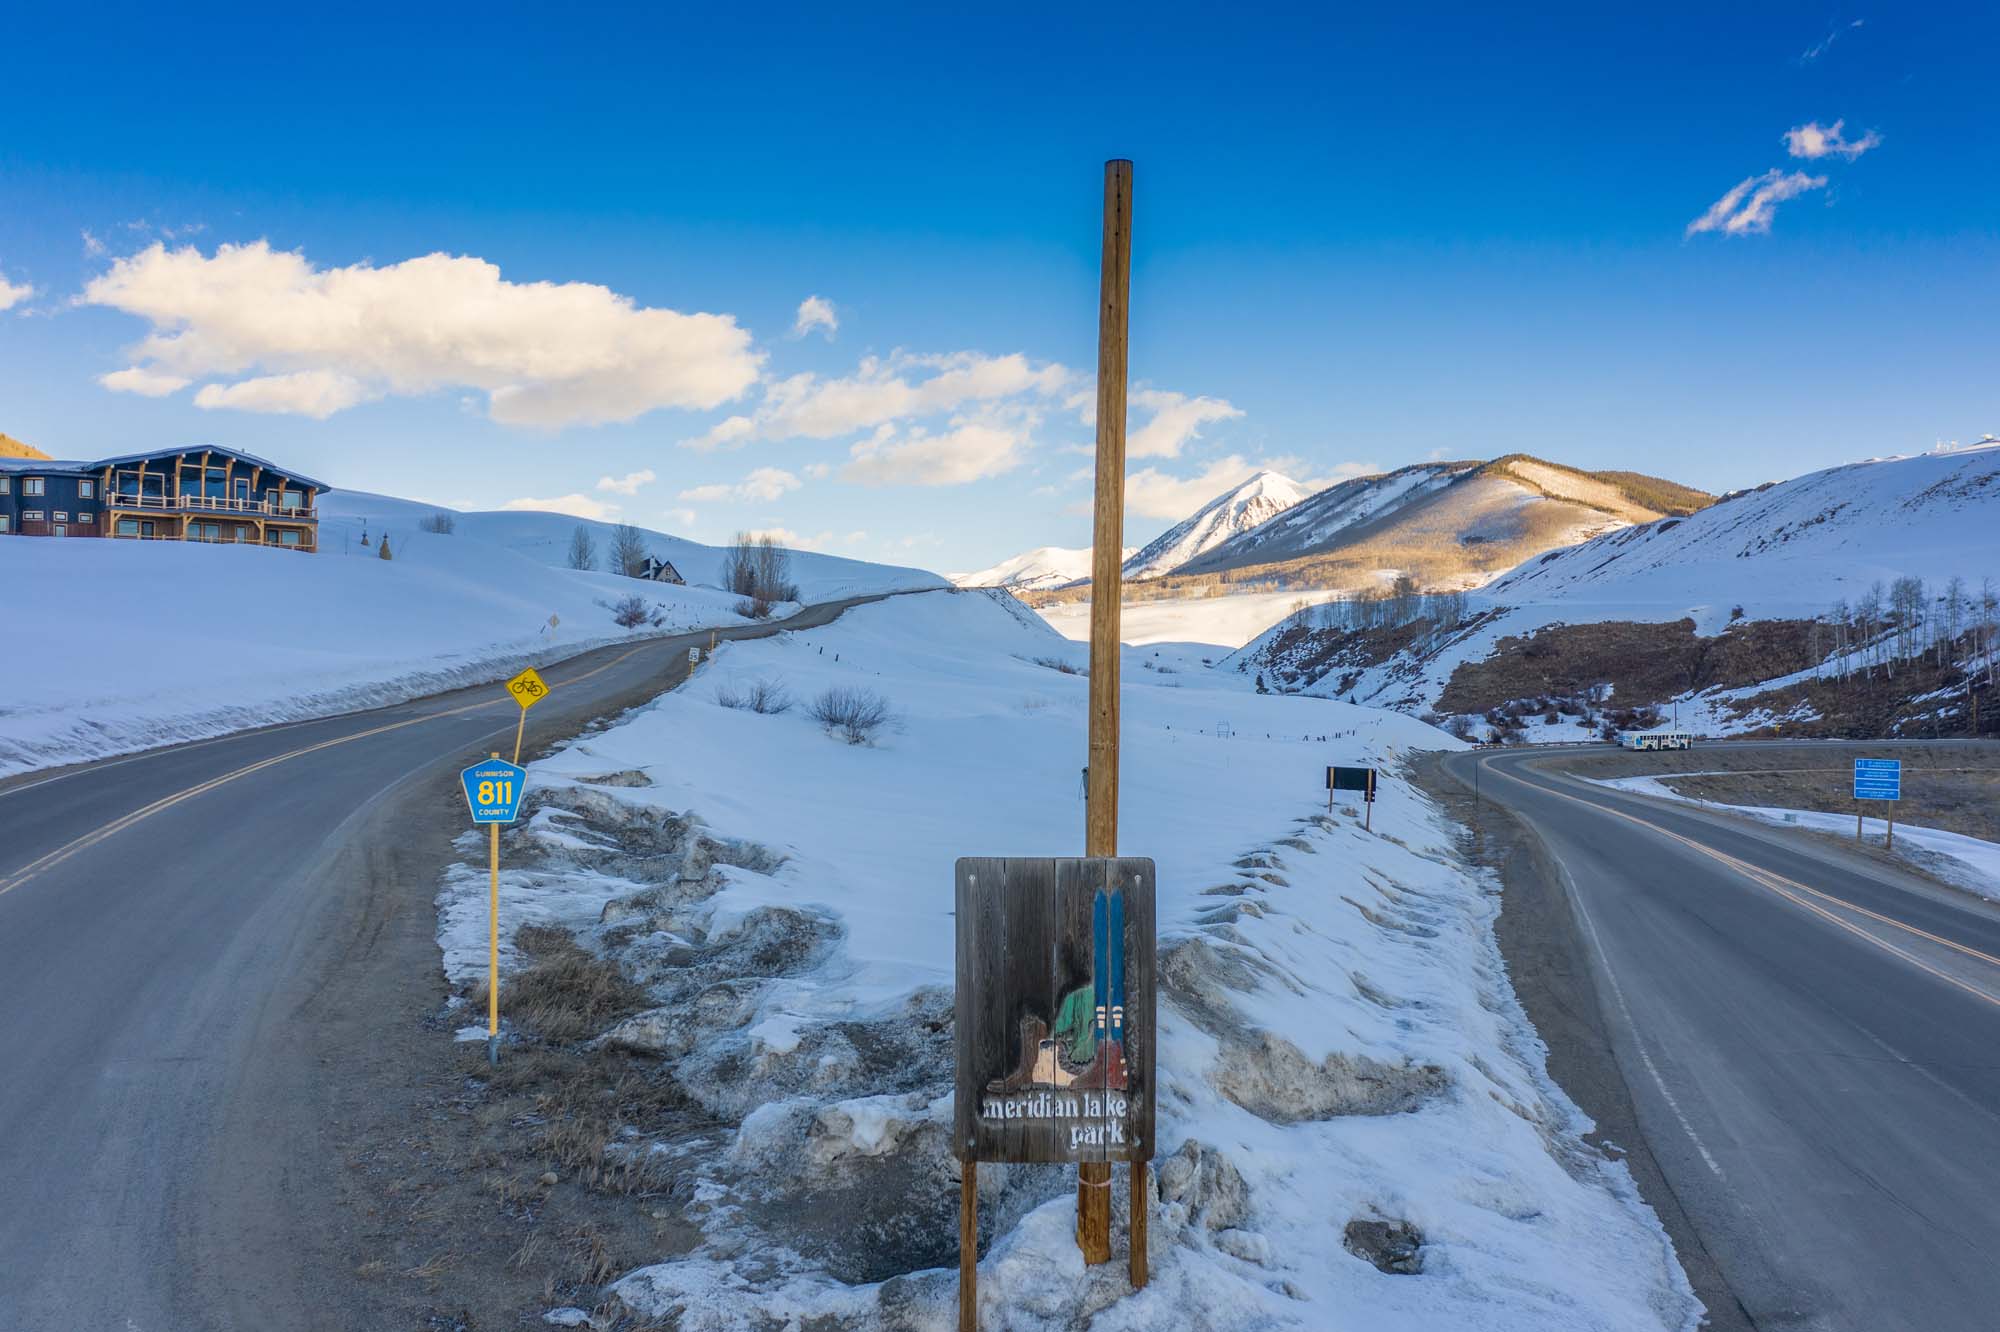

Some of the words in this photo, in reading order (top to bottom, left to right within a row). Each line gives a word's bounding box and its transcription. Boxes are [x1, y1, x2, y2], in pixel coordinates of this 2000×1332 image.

[478, 781, 511, 805] 811
[983, 1093, 1078, 1119] meridian
[1083, 1093, 1127, 1118] lake
[1070, 1118, 1125, 1149] park
